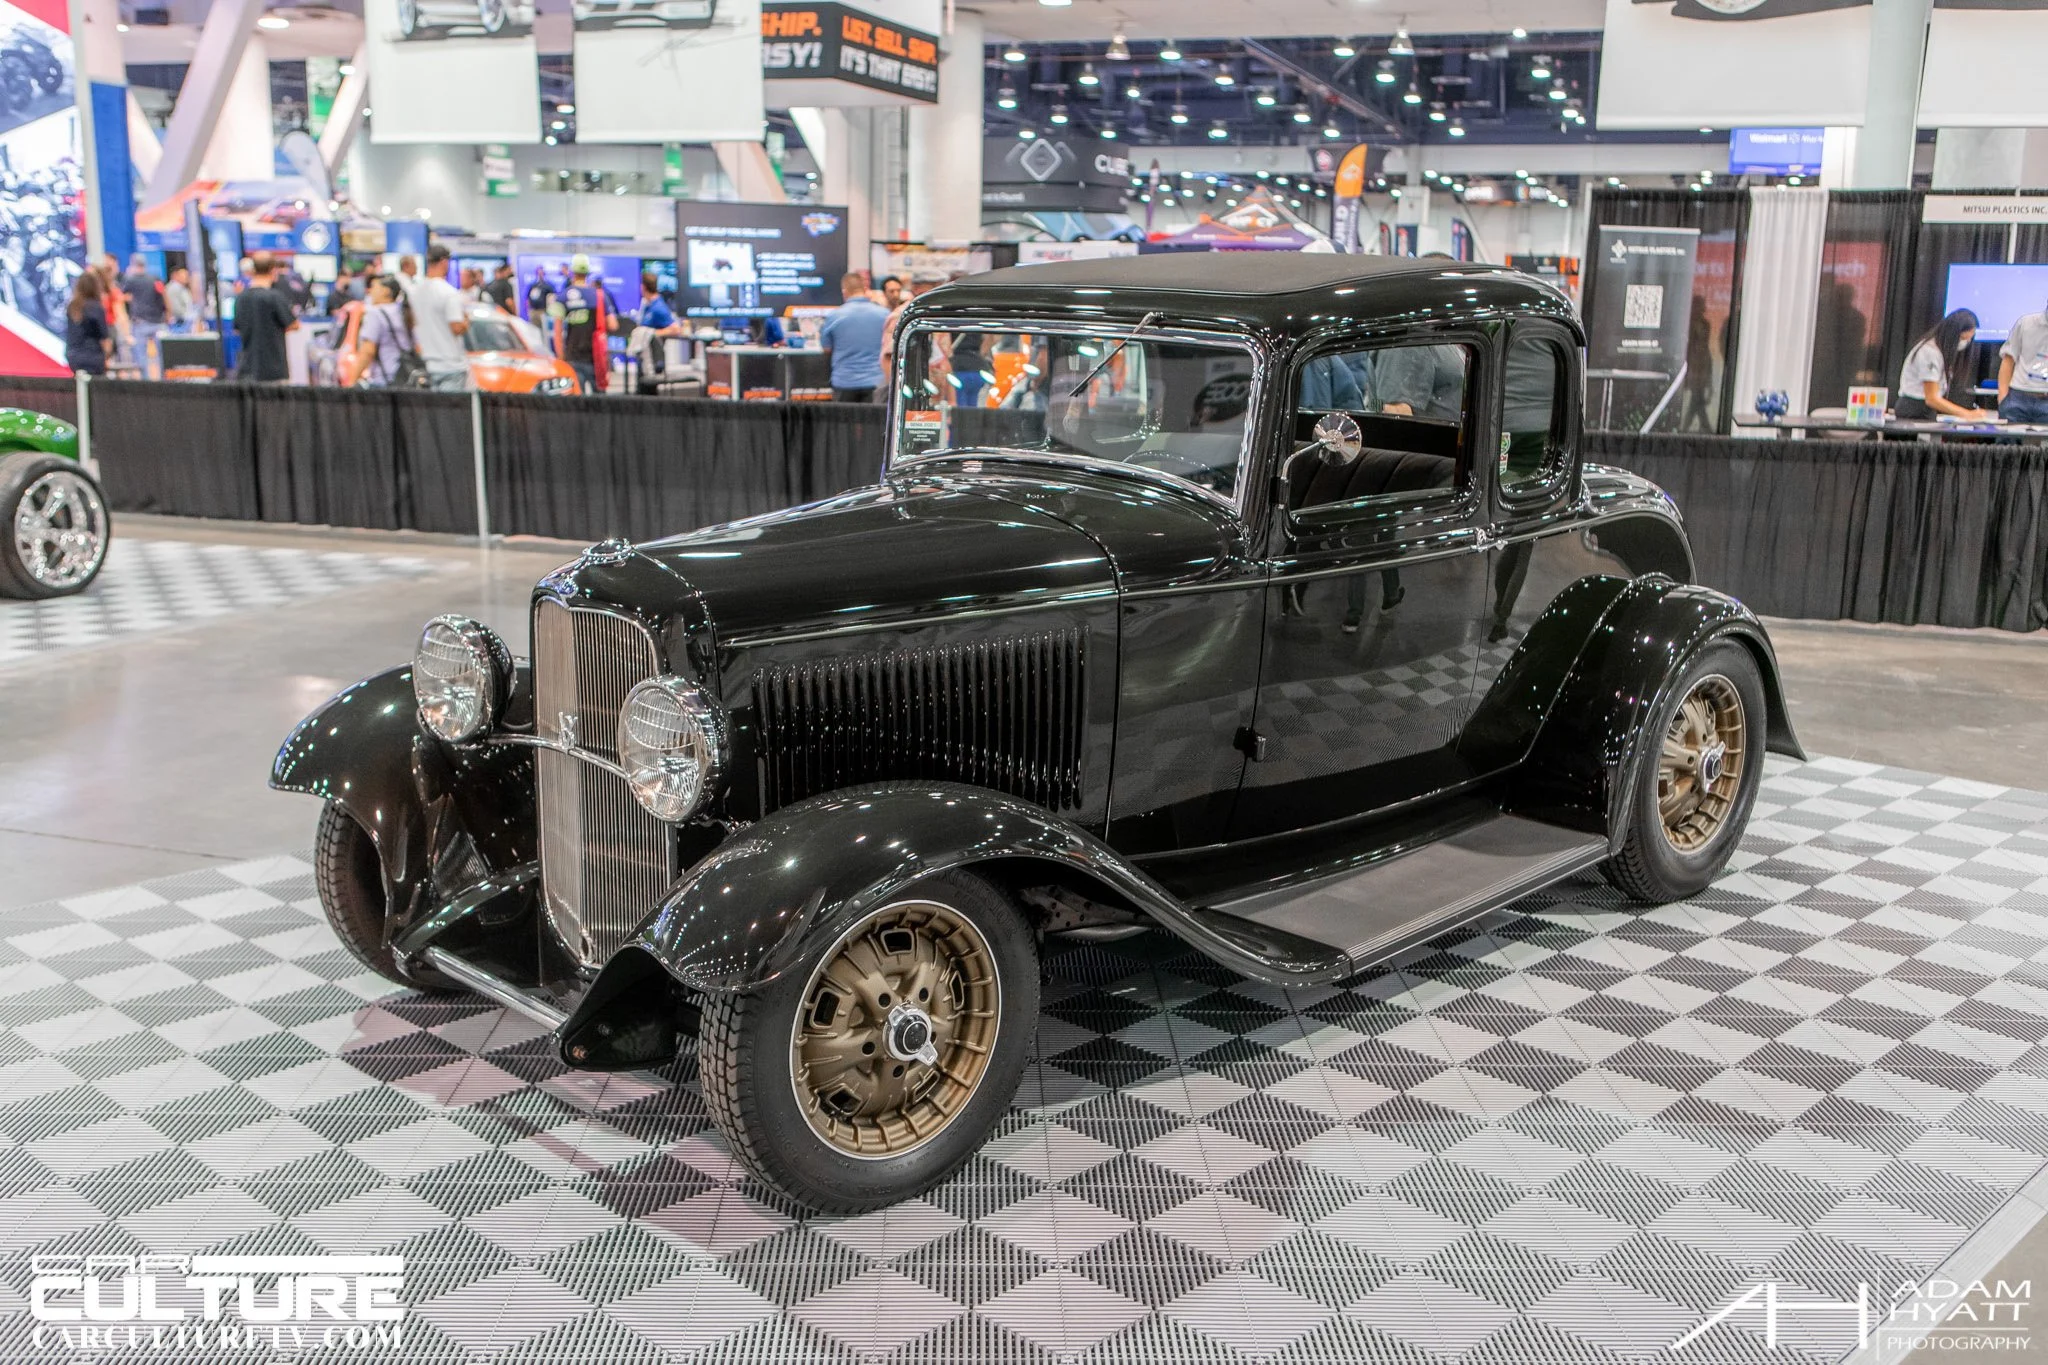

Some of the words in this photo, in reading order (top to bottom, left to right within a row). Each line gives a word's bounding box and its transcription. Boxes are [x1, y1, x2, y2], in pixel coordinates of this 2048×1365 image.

[842, 15, 873, 46] LIST.
[874, 26, 907, 58] SELL.
[840, 45, 867, 75] IT'S
[868, 53, 901, 84] THAT
[901, 62, 937, 93] EASY!
[1962, 205, 1991, 214] MITSUI
[1992, 205, 2029, 214] PLASTICS
[2031, 206, 2048, 214] INC.
